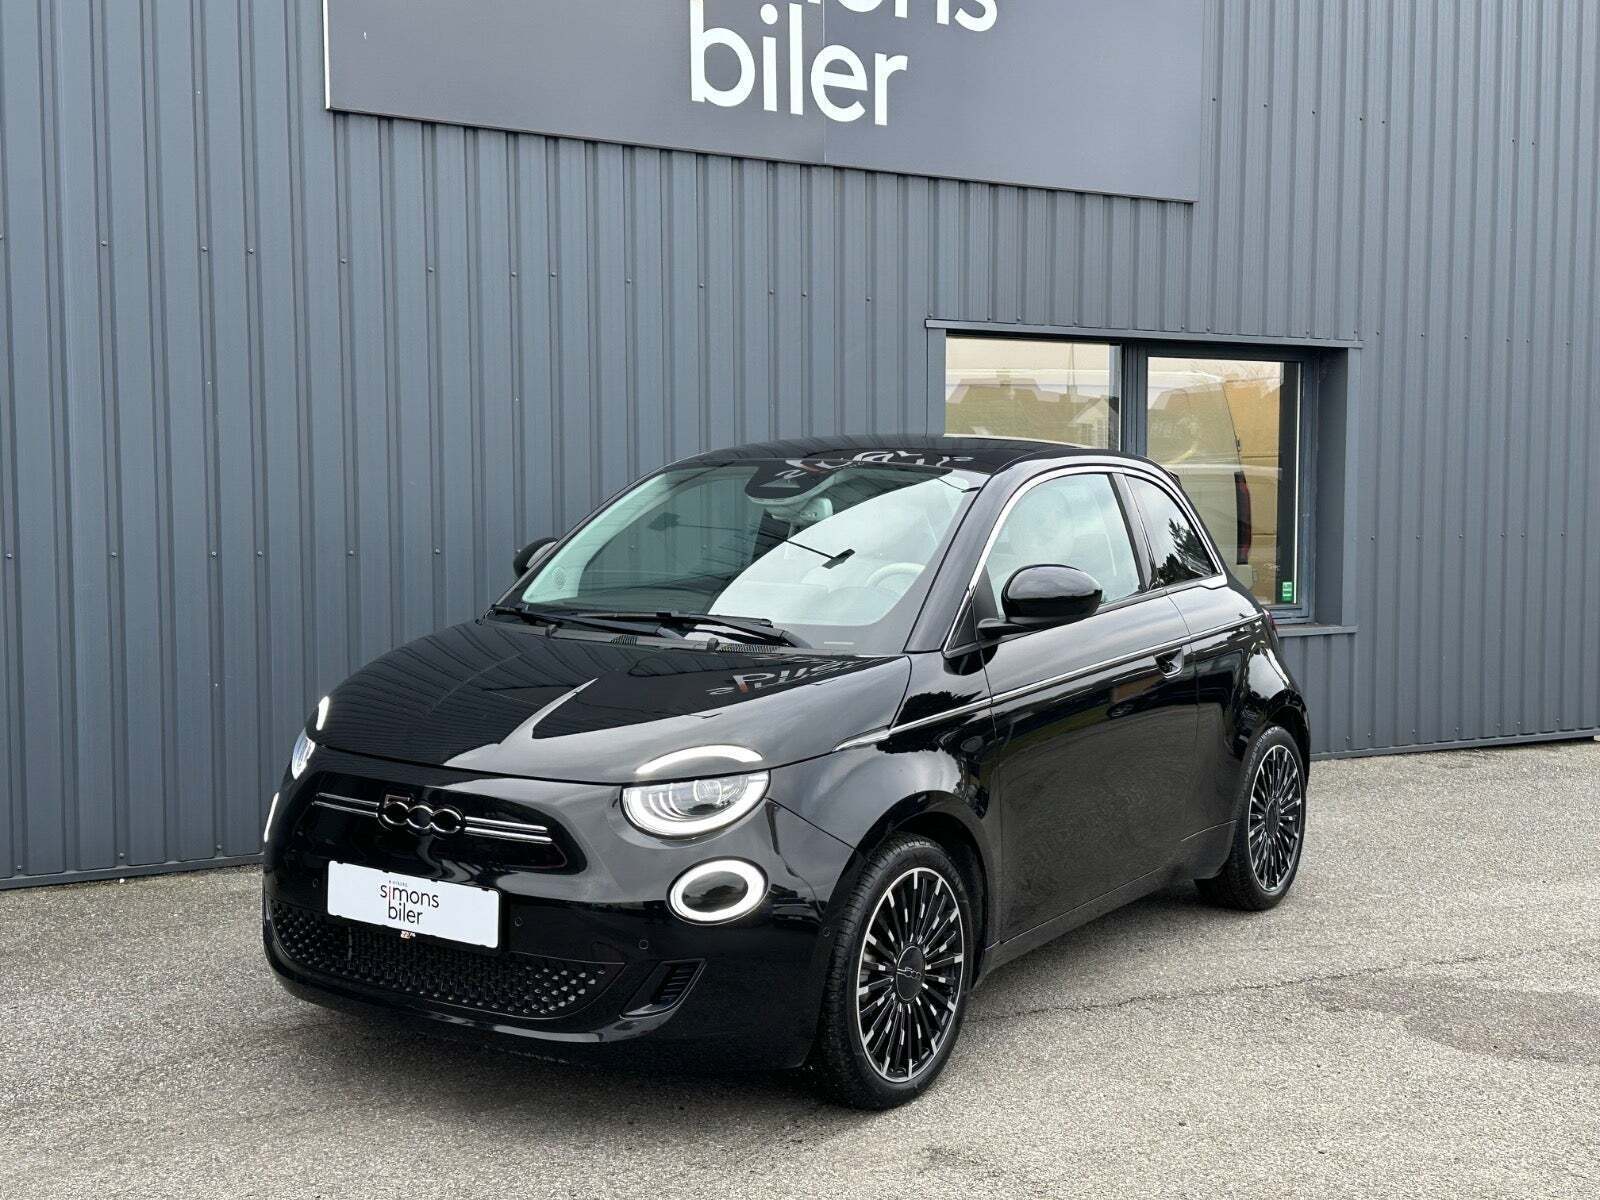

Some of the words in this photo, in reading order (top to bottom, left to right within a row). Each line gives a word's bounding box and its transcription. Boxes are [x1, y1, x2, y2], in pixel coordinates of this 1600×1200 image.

[690, 0, 908, 126] biler
[380, 880, 440, 909] simons
[388, 901, 423, 925] biler
